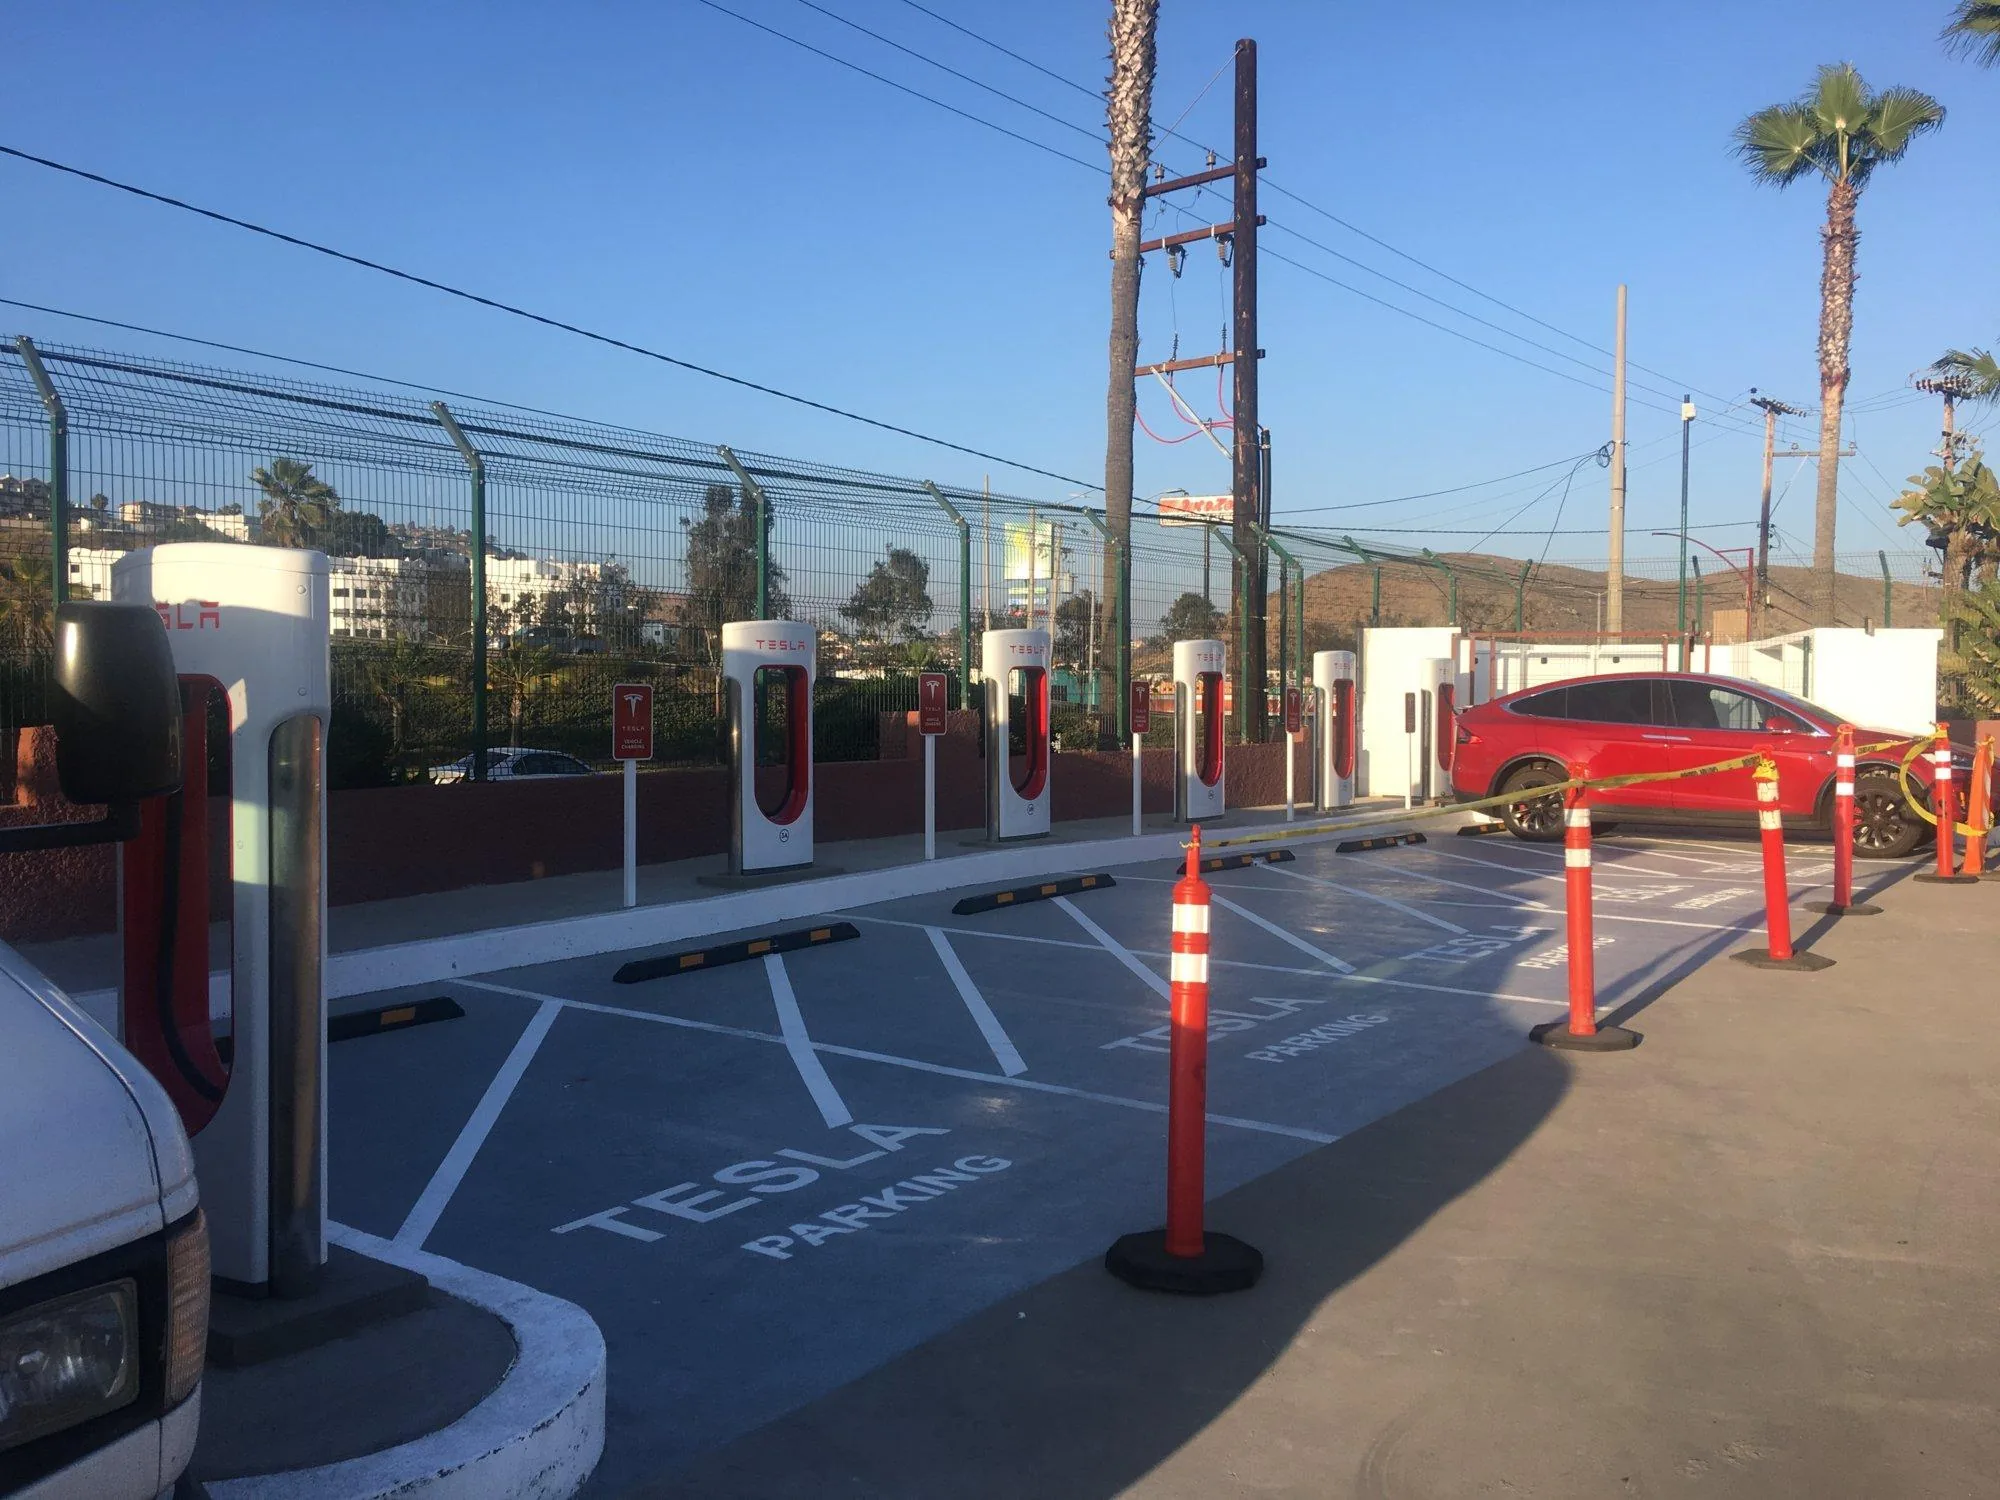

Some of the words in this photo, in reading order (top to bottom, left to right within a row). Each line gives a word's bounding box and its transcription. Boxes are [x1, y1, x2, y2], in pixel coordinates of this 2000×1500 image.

[156, 602, 219, 630] SLA
[756, 640, 806, 650] TESLA
[1010, 645, 1045, 654] TESLA
[1399, 925, 1556, 964] TESLA
[1245, 1014, 1389, 1063] PARKING
[550, 1123, 952, 1242] TESLA
[741, 1155, 1013, 1260] PARKING
